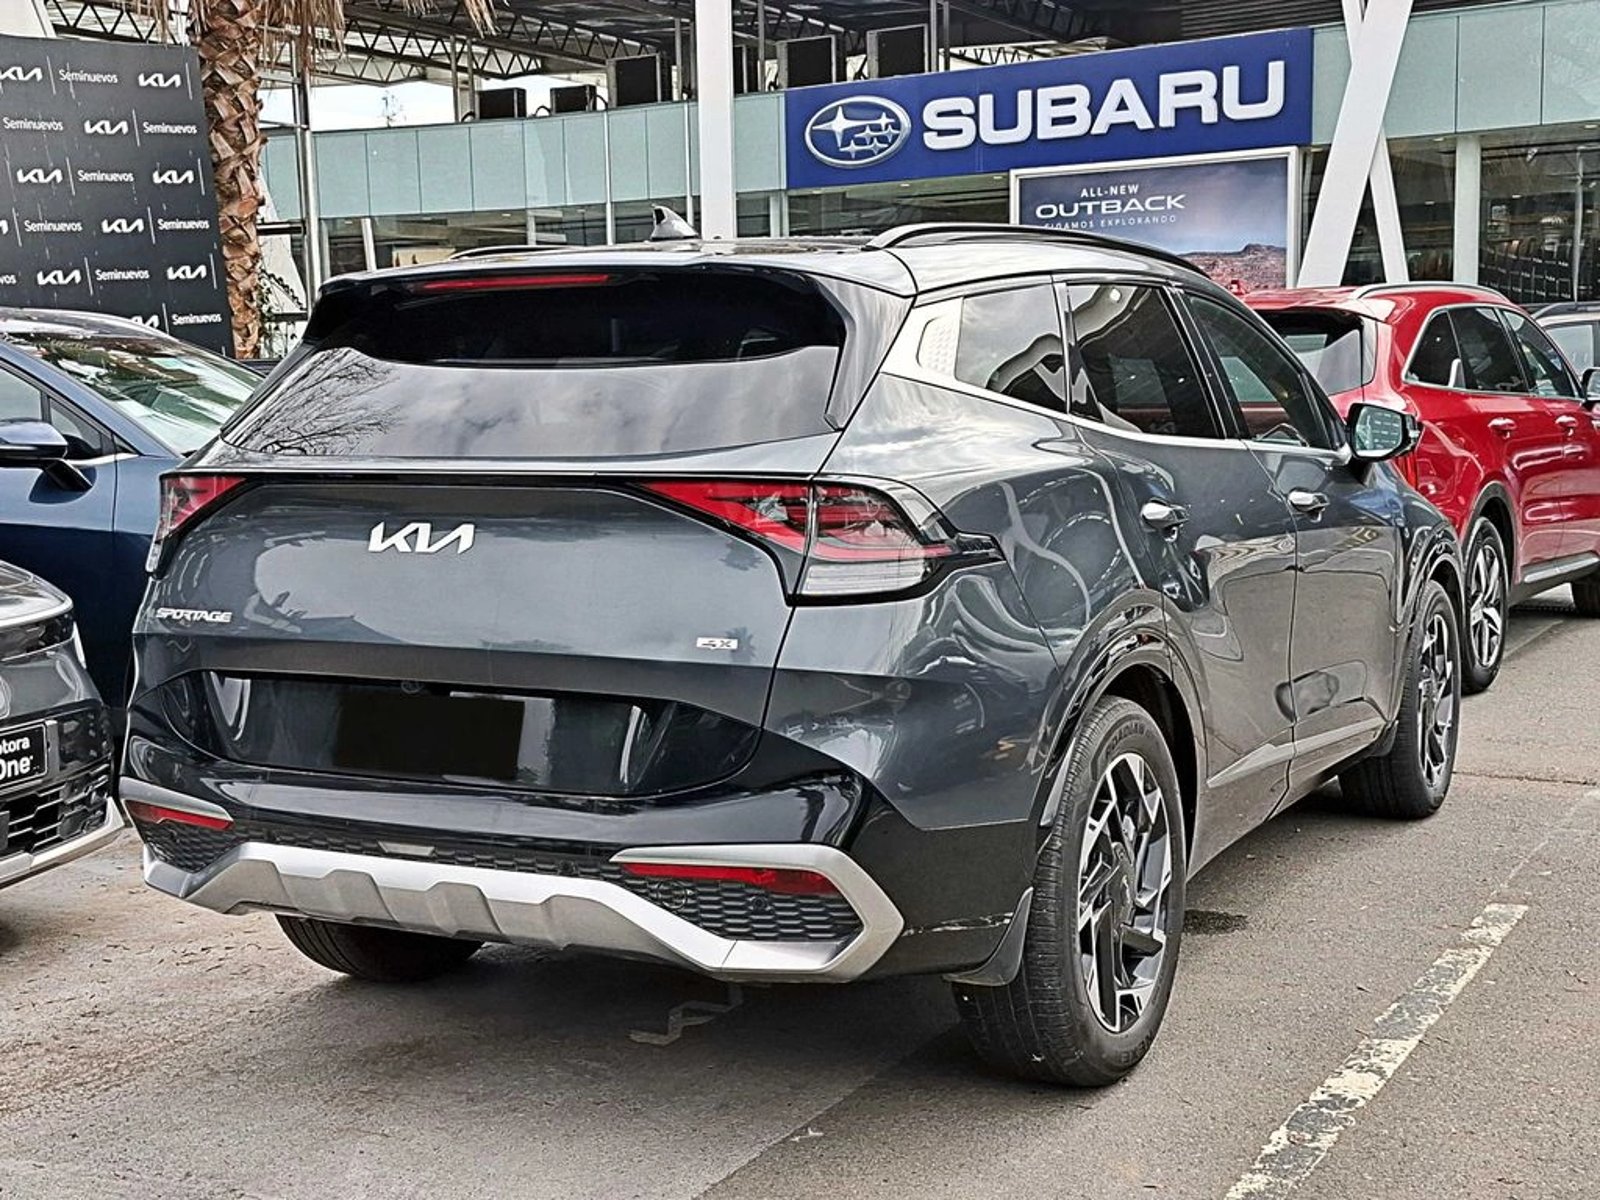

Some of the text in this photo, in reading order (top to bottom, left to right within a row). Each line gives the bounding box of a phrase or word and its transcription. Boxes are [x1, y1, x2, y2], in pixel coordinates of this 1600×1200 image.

[0, 67, 181, 87] KIA Seminuevos KIA
[922, 59, 1286, 151] SUBARU
[3, 117, 197, 135] Seminuevos KIA Seminuevos
[17, 168, 194, 184] KIA Seminuevos KIA
[1080, 184, 1139, 198] ALL-NEW
[1035, 194, 1186, 220] OUTBACK
[24, 219, 83, 233] Seminuevos
[102, 218, 144, 233] KIA
[158, 218, 209, 230] Seminuevos
[1101, 214, 1177, 228] EXPLORANDO
[37, 264, 206, 285] KIA Seminuevos KIA
[172, 313, 222, 326] Seminuevos
[368, 521, 475, 554] KIA
[156, 607, 232, 623] SPORTAGE
[0, 737, 30, 756] tora
